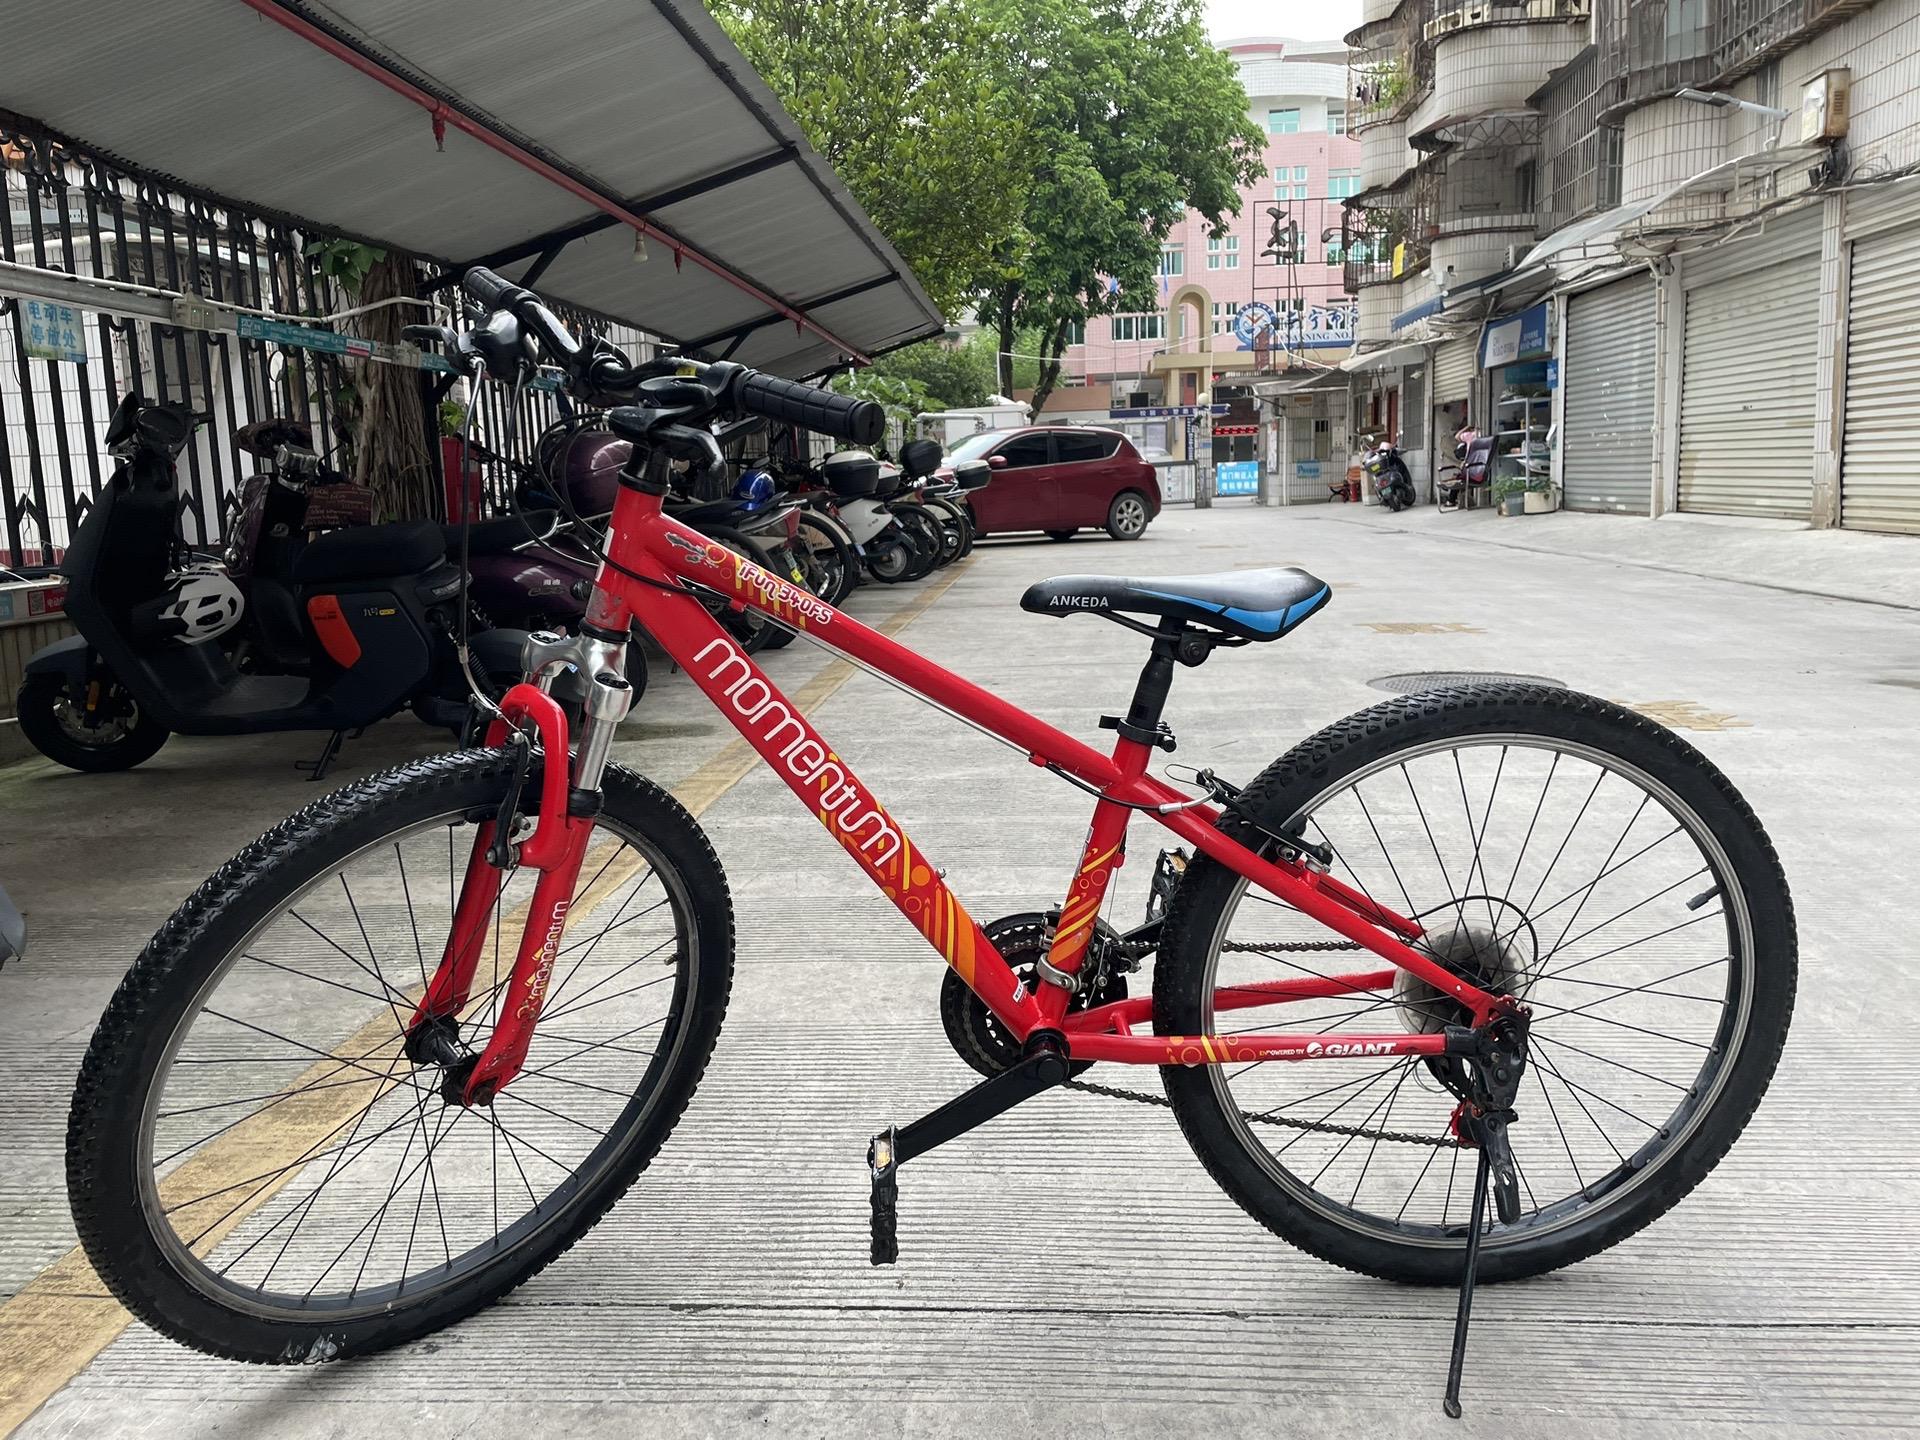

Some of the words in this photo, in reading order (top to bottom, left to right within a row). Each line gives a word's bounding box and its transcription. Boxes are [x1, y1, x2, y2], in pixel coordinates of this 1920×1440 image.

[27, 300, 73, 325] 电动车
[31, 323, 77, 349] 停放处
[737, 560, 777, 600] iFun
[777, 583, 834, 625] 340FS
[1048, 595, 1109, 608] ANKEDA
[692, 638, 901, 868] momentum
[1325, 1042, 1397, 1056] GIANT
